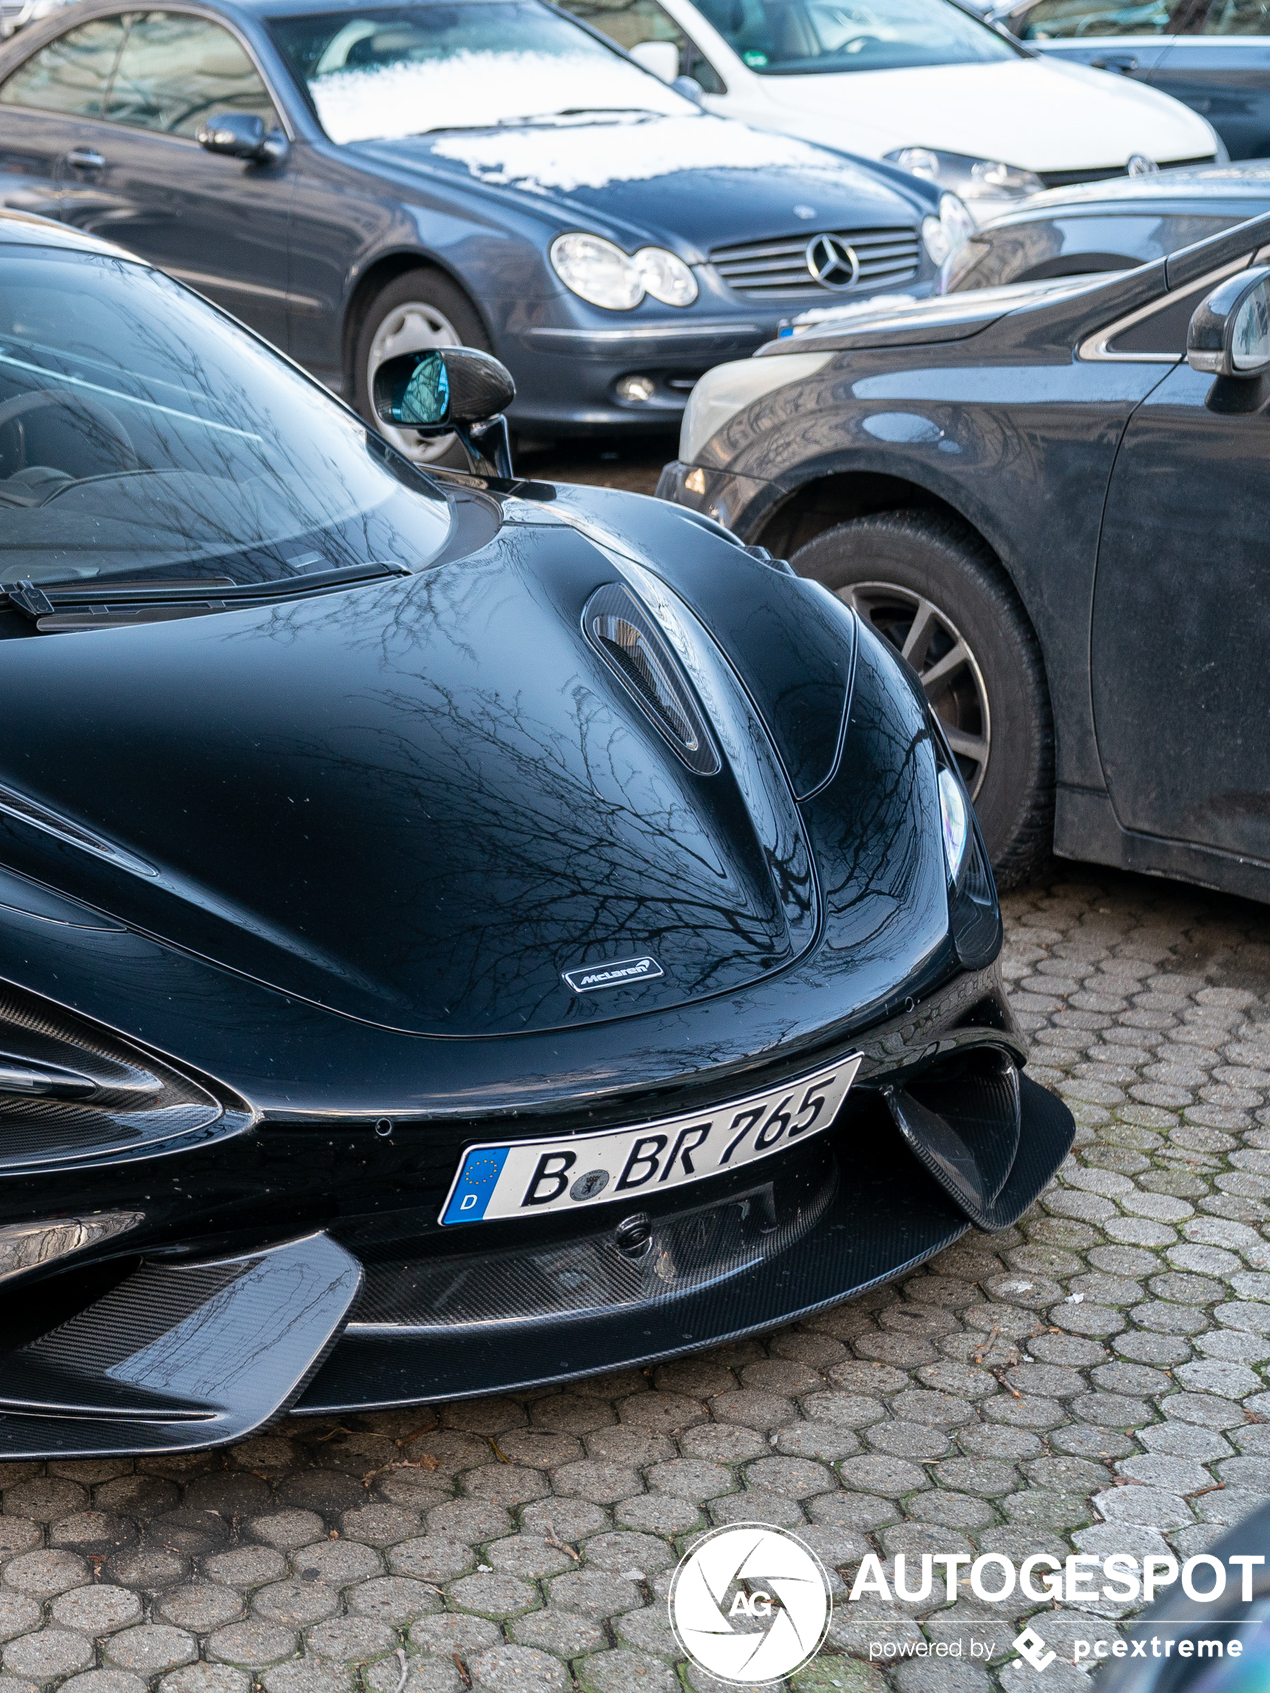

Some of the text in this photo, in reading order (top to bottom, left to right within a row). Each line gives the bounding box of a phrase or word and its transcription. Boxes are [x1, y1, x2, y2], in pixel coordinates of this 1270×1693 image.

[580, 965, 648, 985] McLaren
[520, 1151, 577, 1208] B
[614, 1123, 714, 1191] BR
[718, 1075, 837, 1166] 765
[460, 1194, 478, 1210] D
